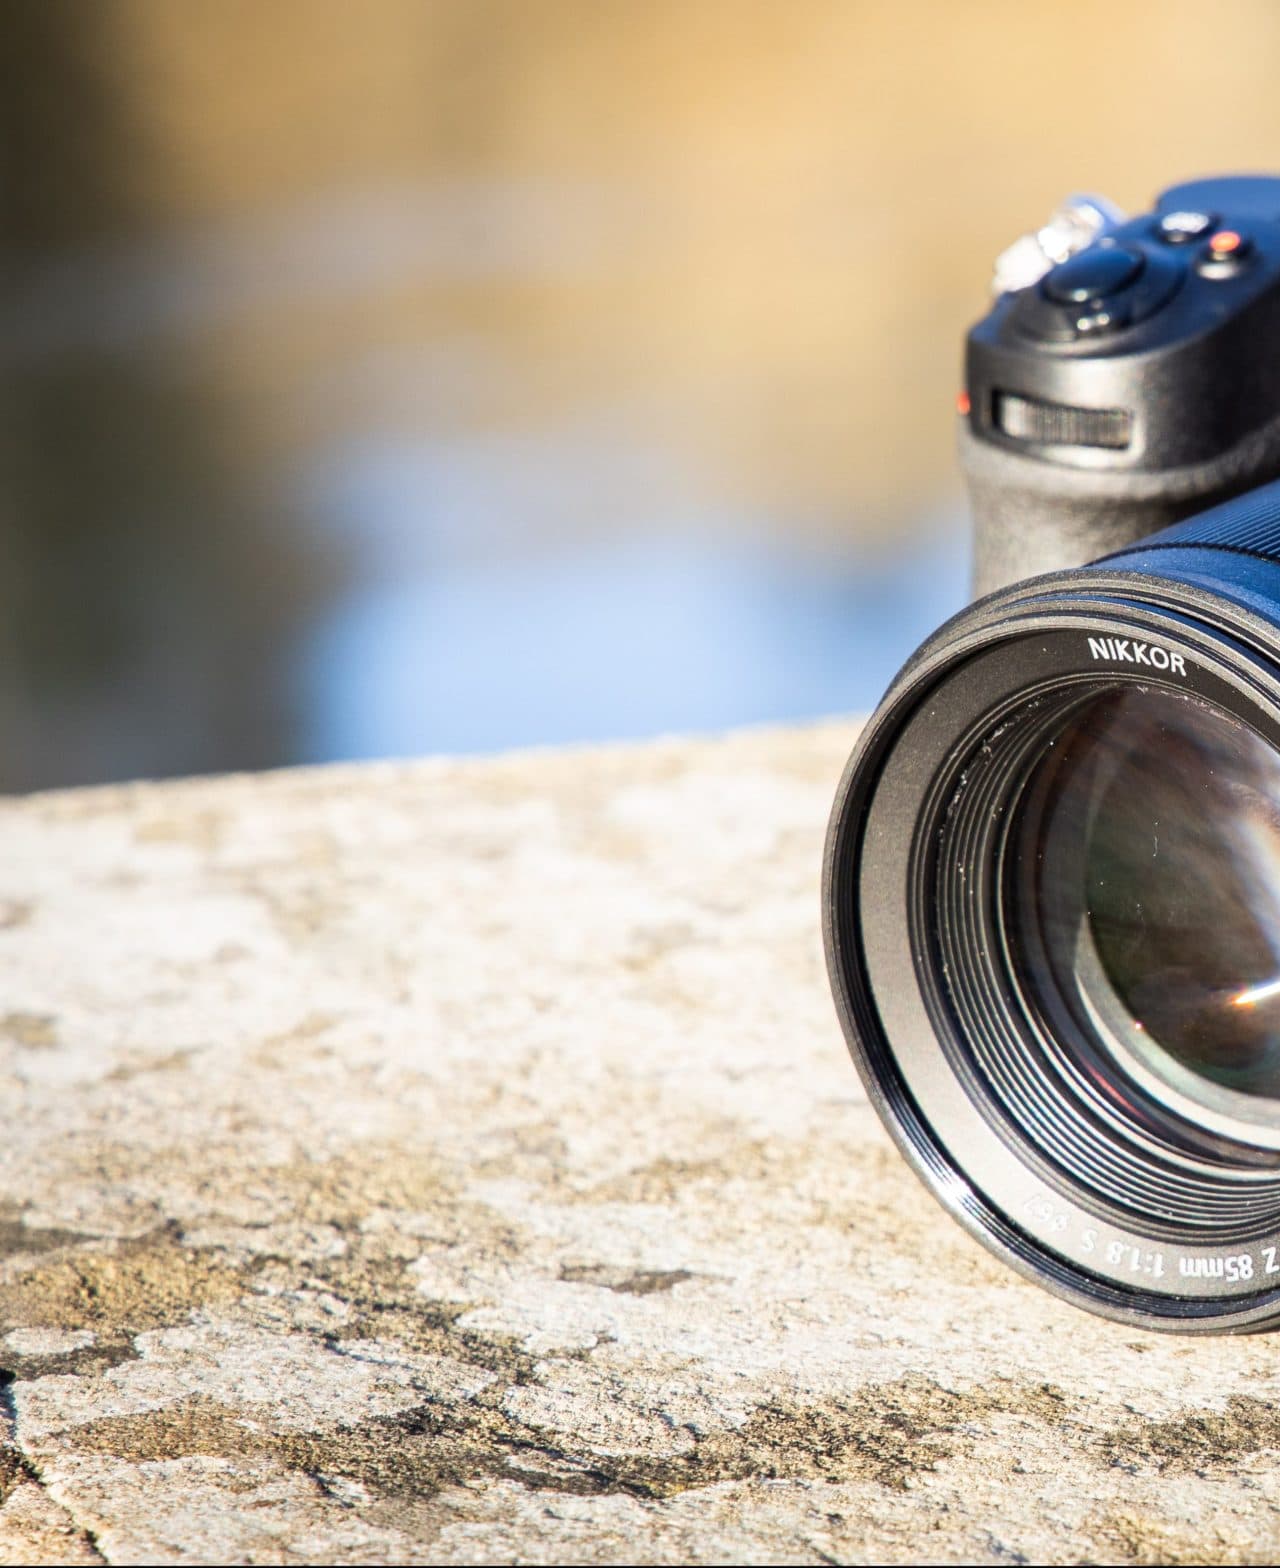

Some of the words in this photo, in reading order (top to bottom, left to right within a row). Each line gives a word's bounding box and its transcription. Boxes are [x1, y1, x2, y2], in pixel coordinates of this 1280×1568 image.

[1086, 636, 1188, 678] NIKKOR
[1080, 1227, 1099, 1254] S
[1105, 1240, 1166, 1279] 1:1.8
[1178, 1253, 1255, 1283] 85mm
[1260, 1246, 1280, 1275] Z
